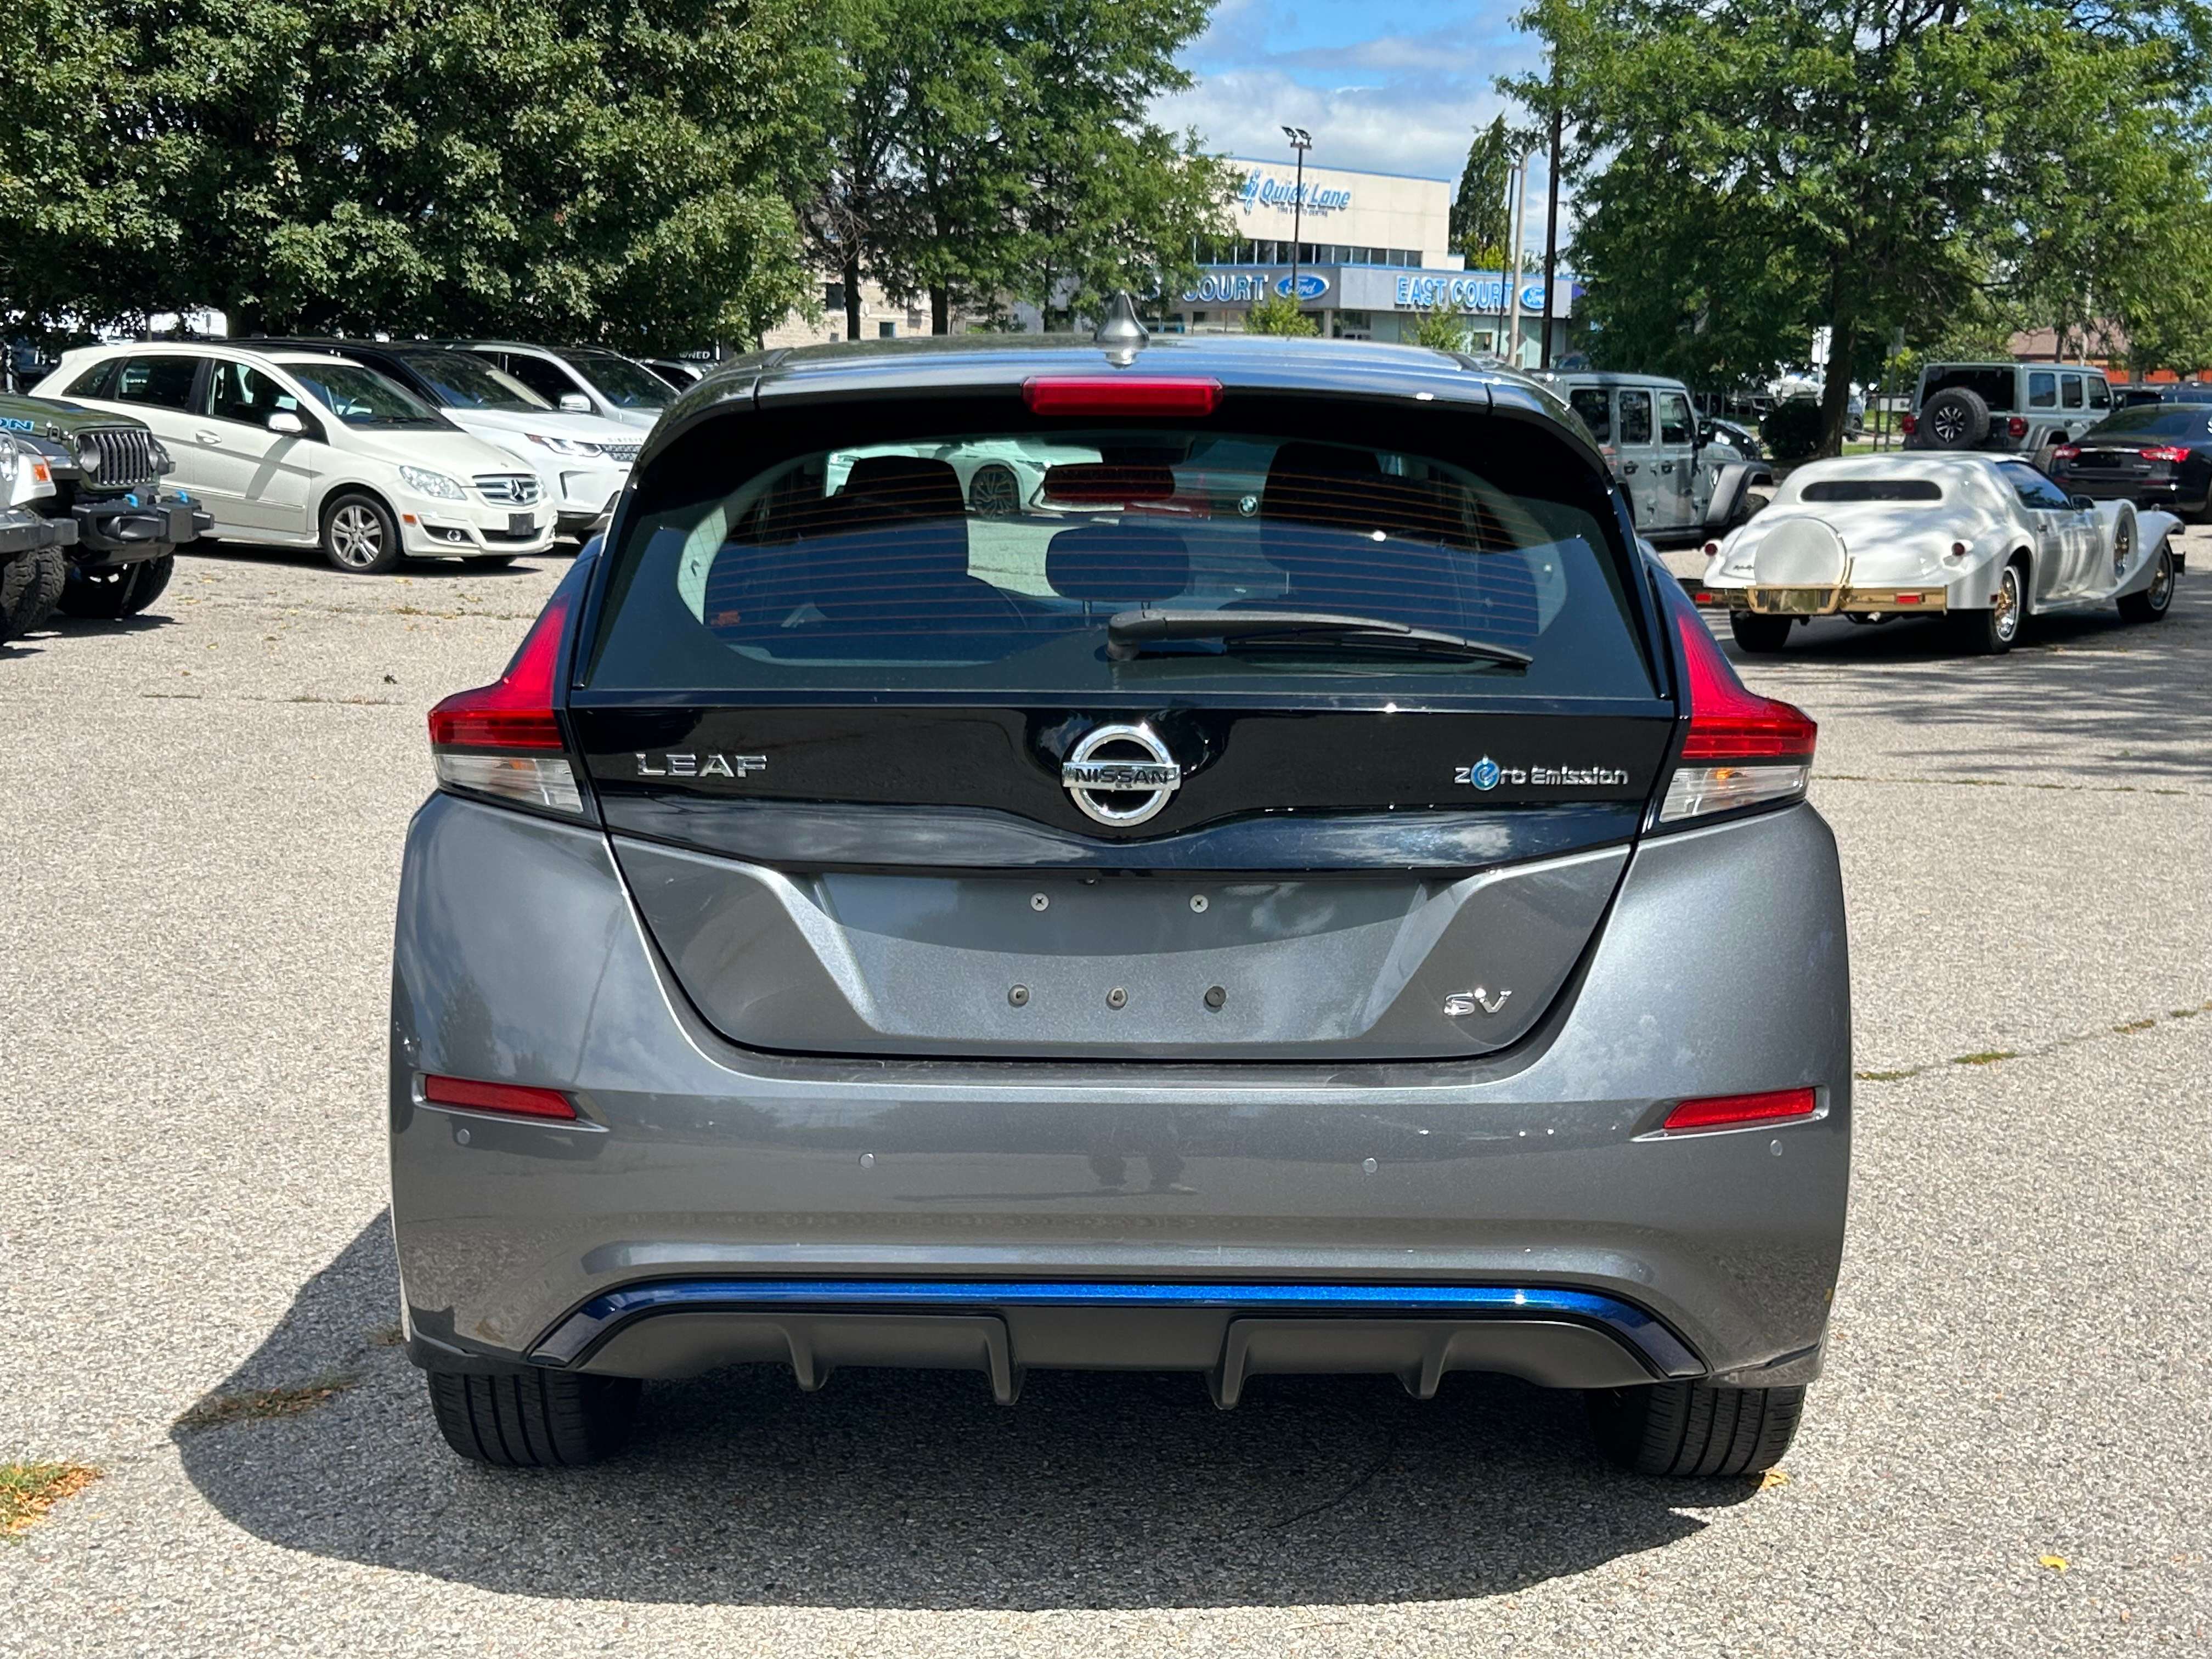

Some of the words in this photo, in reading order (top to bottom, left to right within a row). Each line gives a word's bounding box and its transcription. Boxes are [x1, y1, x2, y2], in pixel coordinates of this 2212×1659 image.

[1261, 177, 1308, 202] Quick
[1310, 183, 1351, 207] Lane
[1396, 275, 1447, 306] EAST
[1450, 278, 1514, 309] COURT
[678, 351, 710, 359] WNED
[636, 753, 767, 778] LEAF
[1075, 768, 1168, 785] NISSAN
[1531, 765, 1629, 786] Emission
[1443, 988, 1513, 1015] SV
